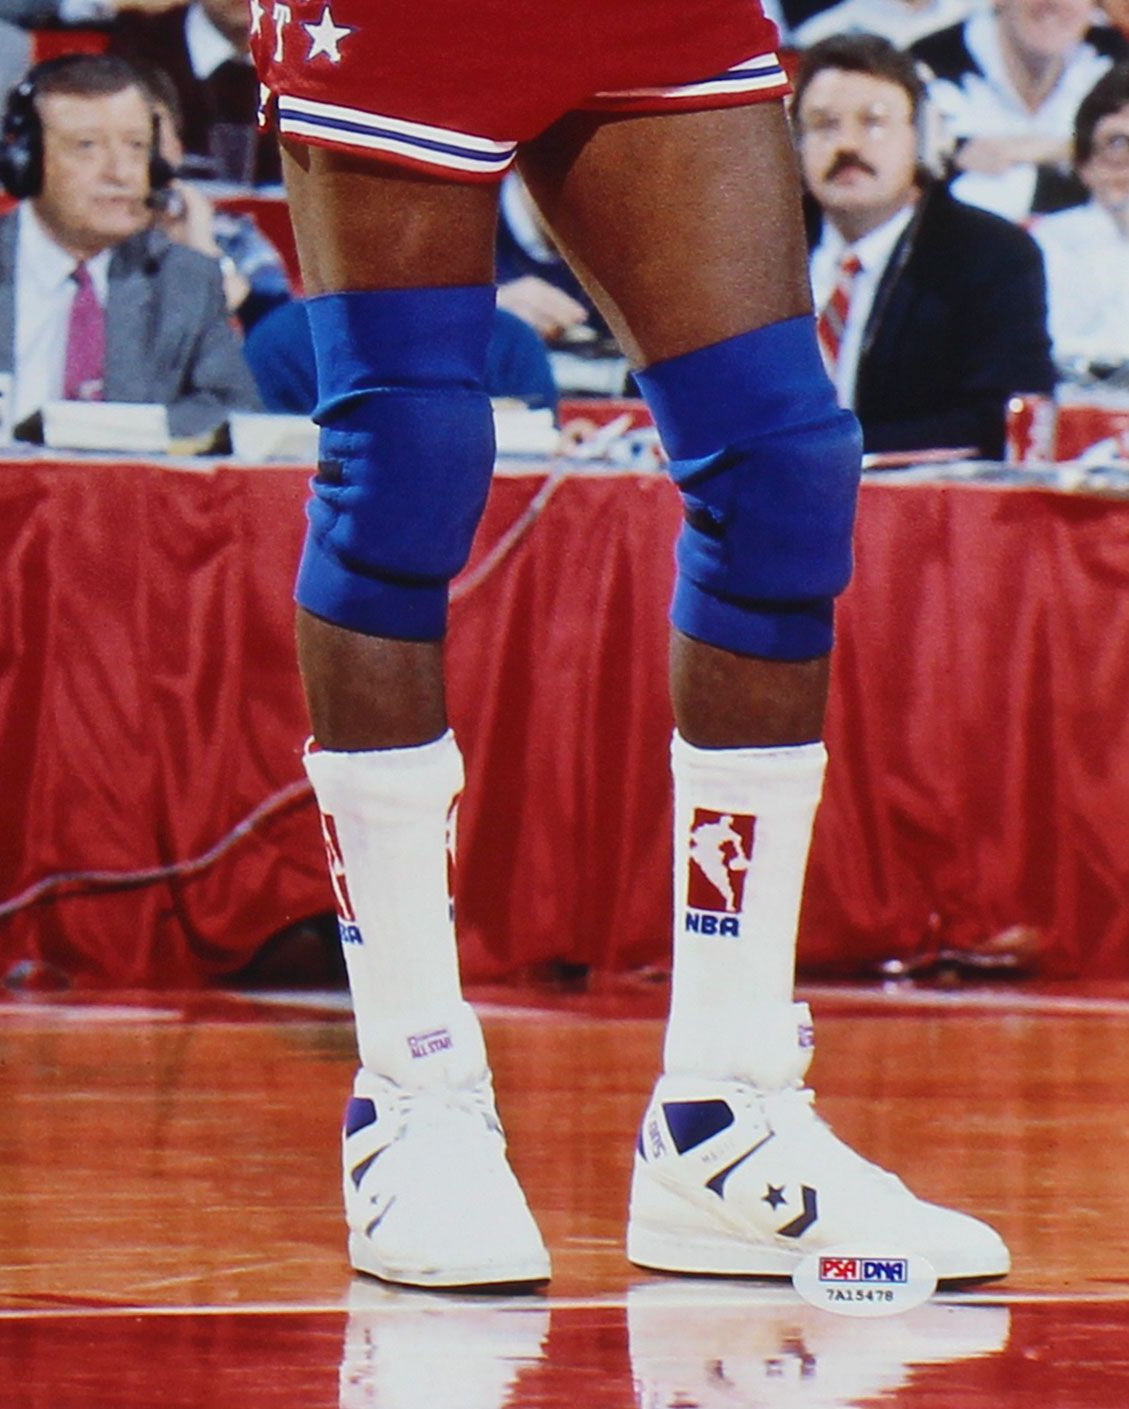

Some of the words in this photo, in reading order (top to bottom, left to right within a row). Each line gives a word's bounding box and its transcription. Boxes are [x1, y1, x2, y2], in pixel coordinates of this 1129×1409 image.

[685, 911, 740, 938] NBA
[821, 1260, 856, 1279] PSA
[863, 1262, 903, 1281] DNA
[826, 1289, 894, 1301] 7A15478
